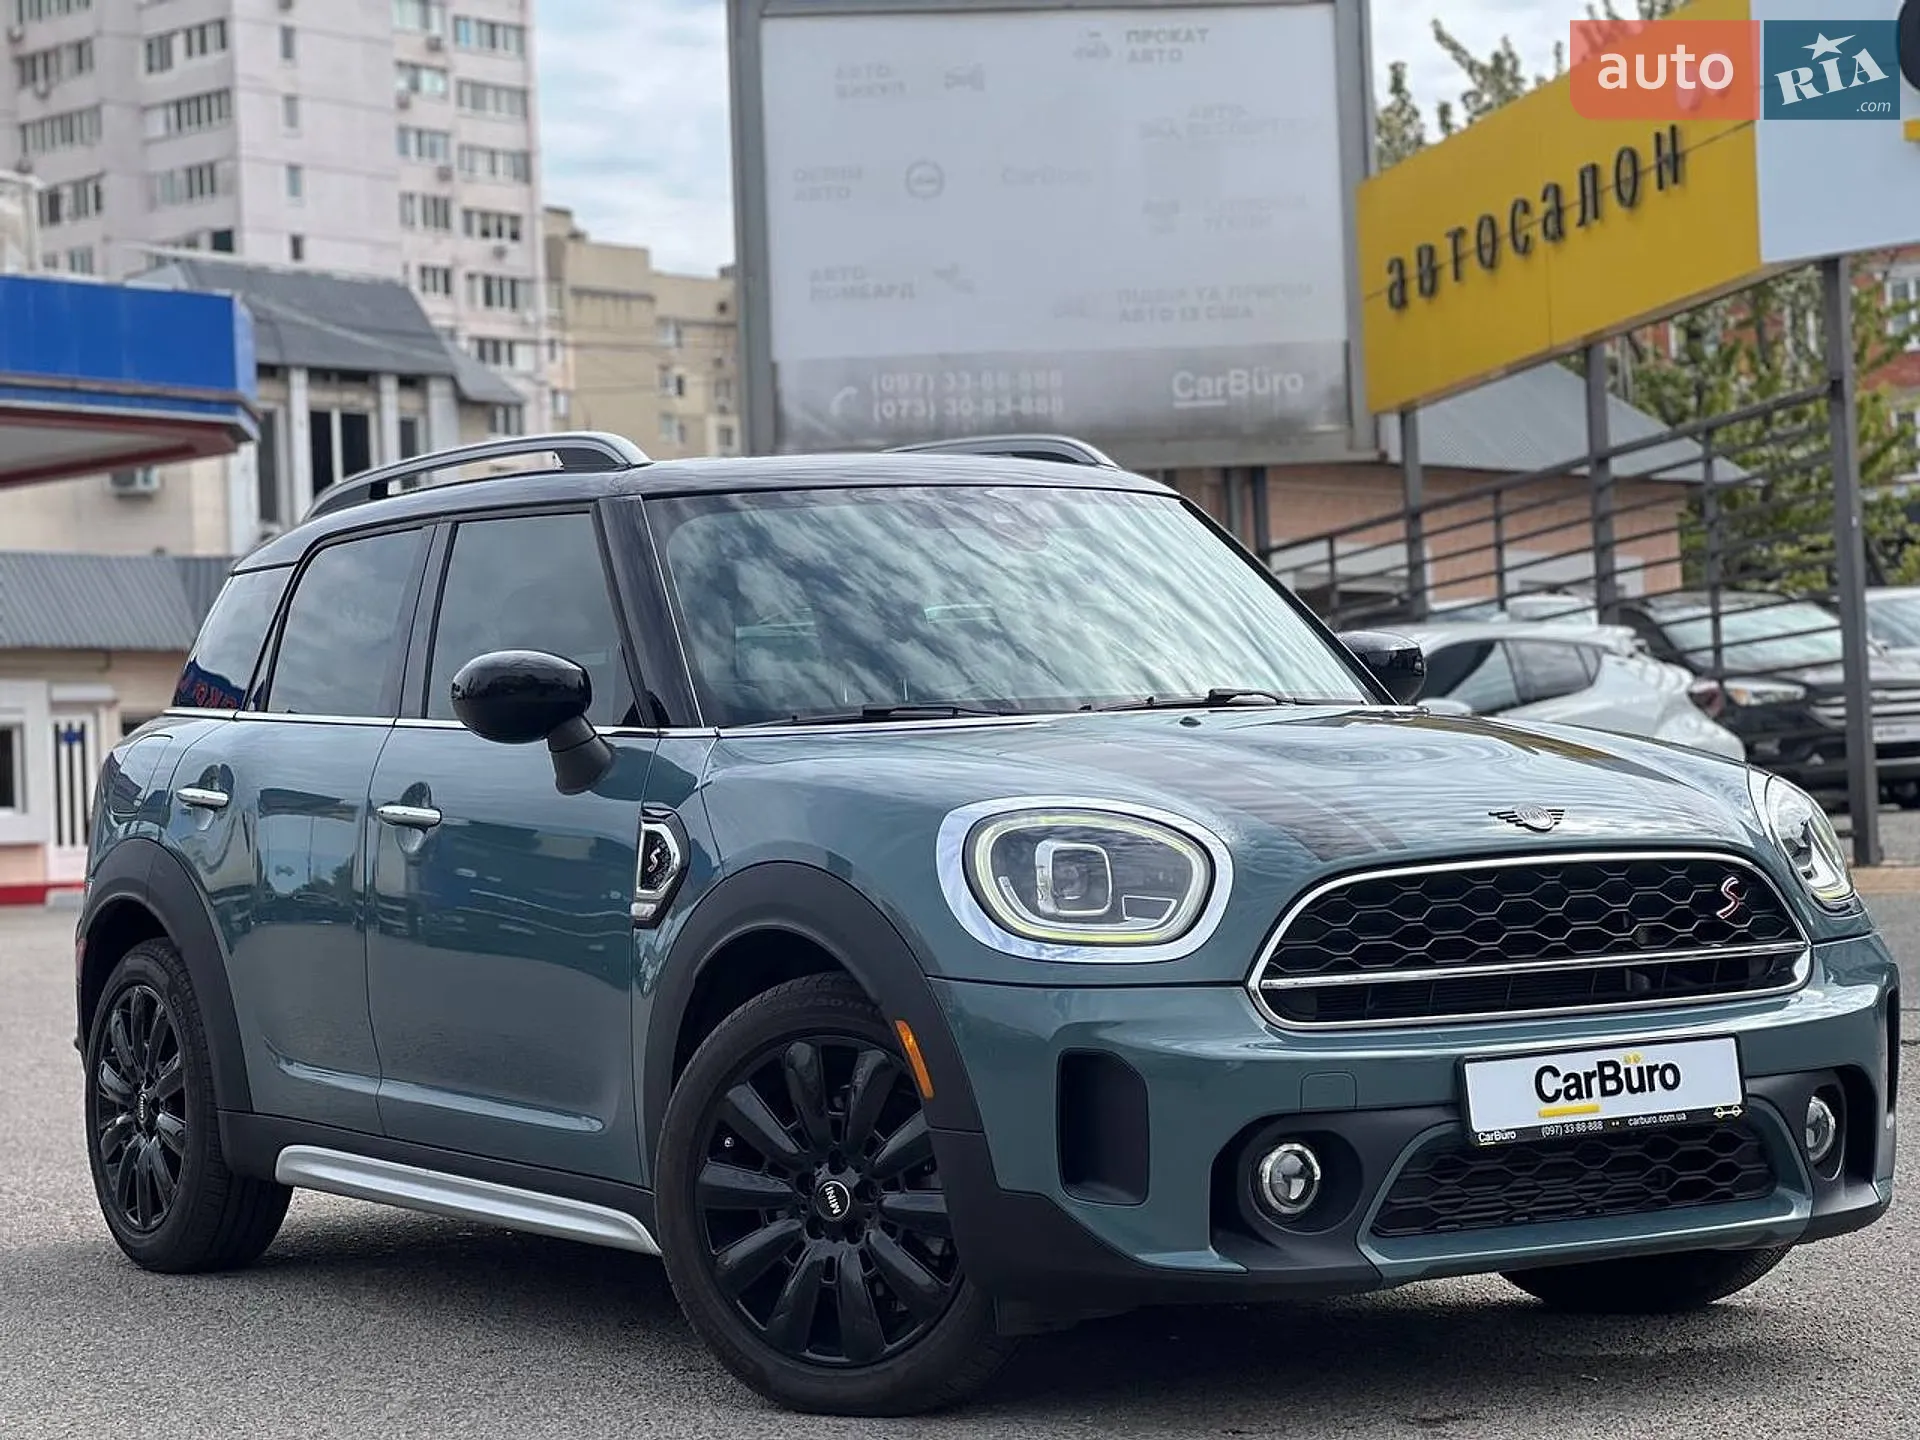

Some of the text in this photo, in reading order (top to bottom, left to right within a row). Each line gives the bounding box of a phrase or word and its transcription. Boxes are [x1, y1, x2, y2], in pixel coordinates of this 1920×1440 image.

[1125, 27, 1209, 46] ПРОКАТ
[1126, 47, 1183, 64] АВТО
[1386, 124, 1685, 313] автосалон
[1171, 366, 1304, 399] CarBüro
[1716, 876, 1739, 920] S
[1534, 1052, 1682, 1104] CarBüro
[1541, 1124, 1563, 1138] (097)
[1628, 1112, 1687, 1127] carburo.com.ua
[824, 1186, 842, 1215] MINI
